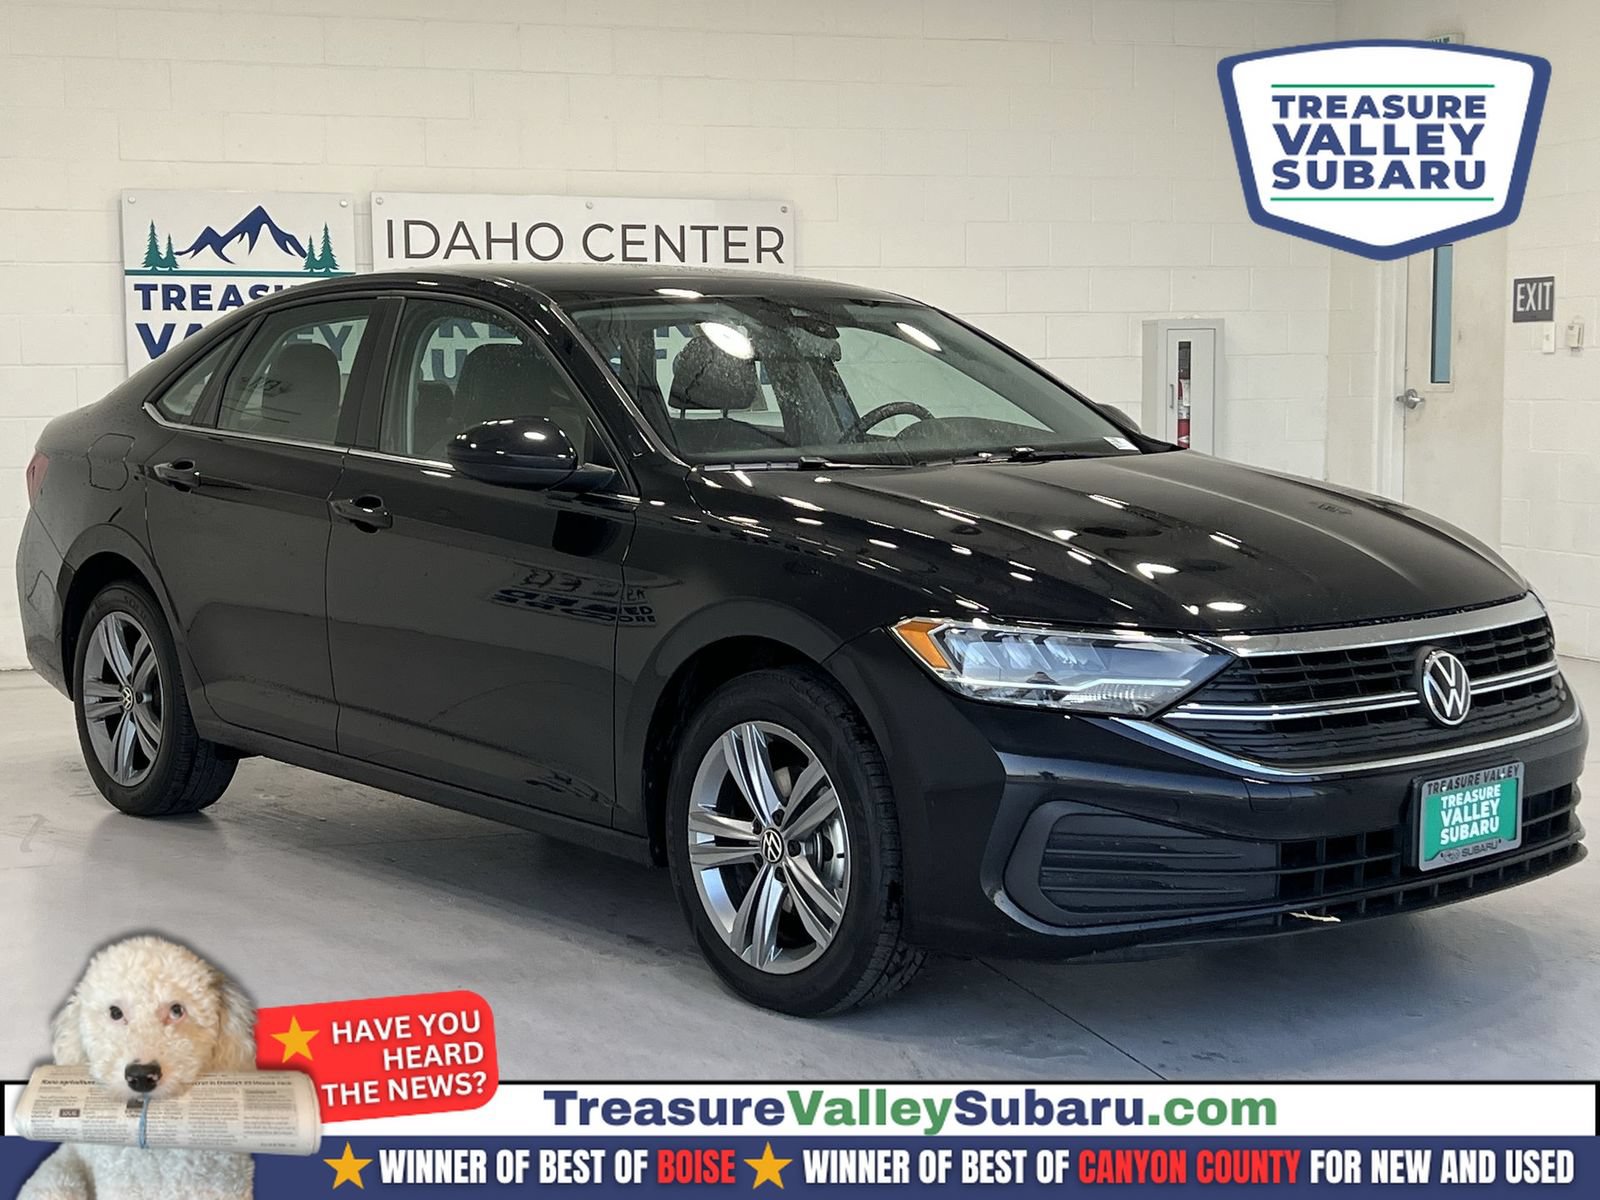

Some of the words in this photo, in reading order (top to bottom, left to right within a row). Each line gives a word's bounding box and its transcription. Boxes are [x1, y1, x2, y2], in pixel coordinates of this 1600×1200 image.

[388, 219, 563, 261] IDAHO
[583, 224, 784, 263] CENTER
[1517, 282, 1552, 311] EXIT
[1427, 773, 1481, 795] TREASURE
[1483, 764, 1520, 783] VALLEY
[1440, 784, 1501, 808] TREASURE
[1440, 798, 1500, 827] VALLEY
[1440, 816, 1499, 845] SUBARU
[1461, 840, 1498, 859] SUBARU
